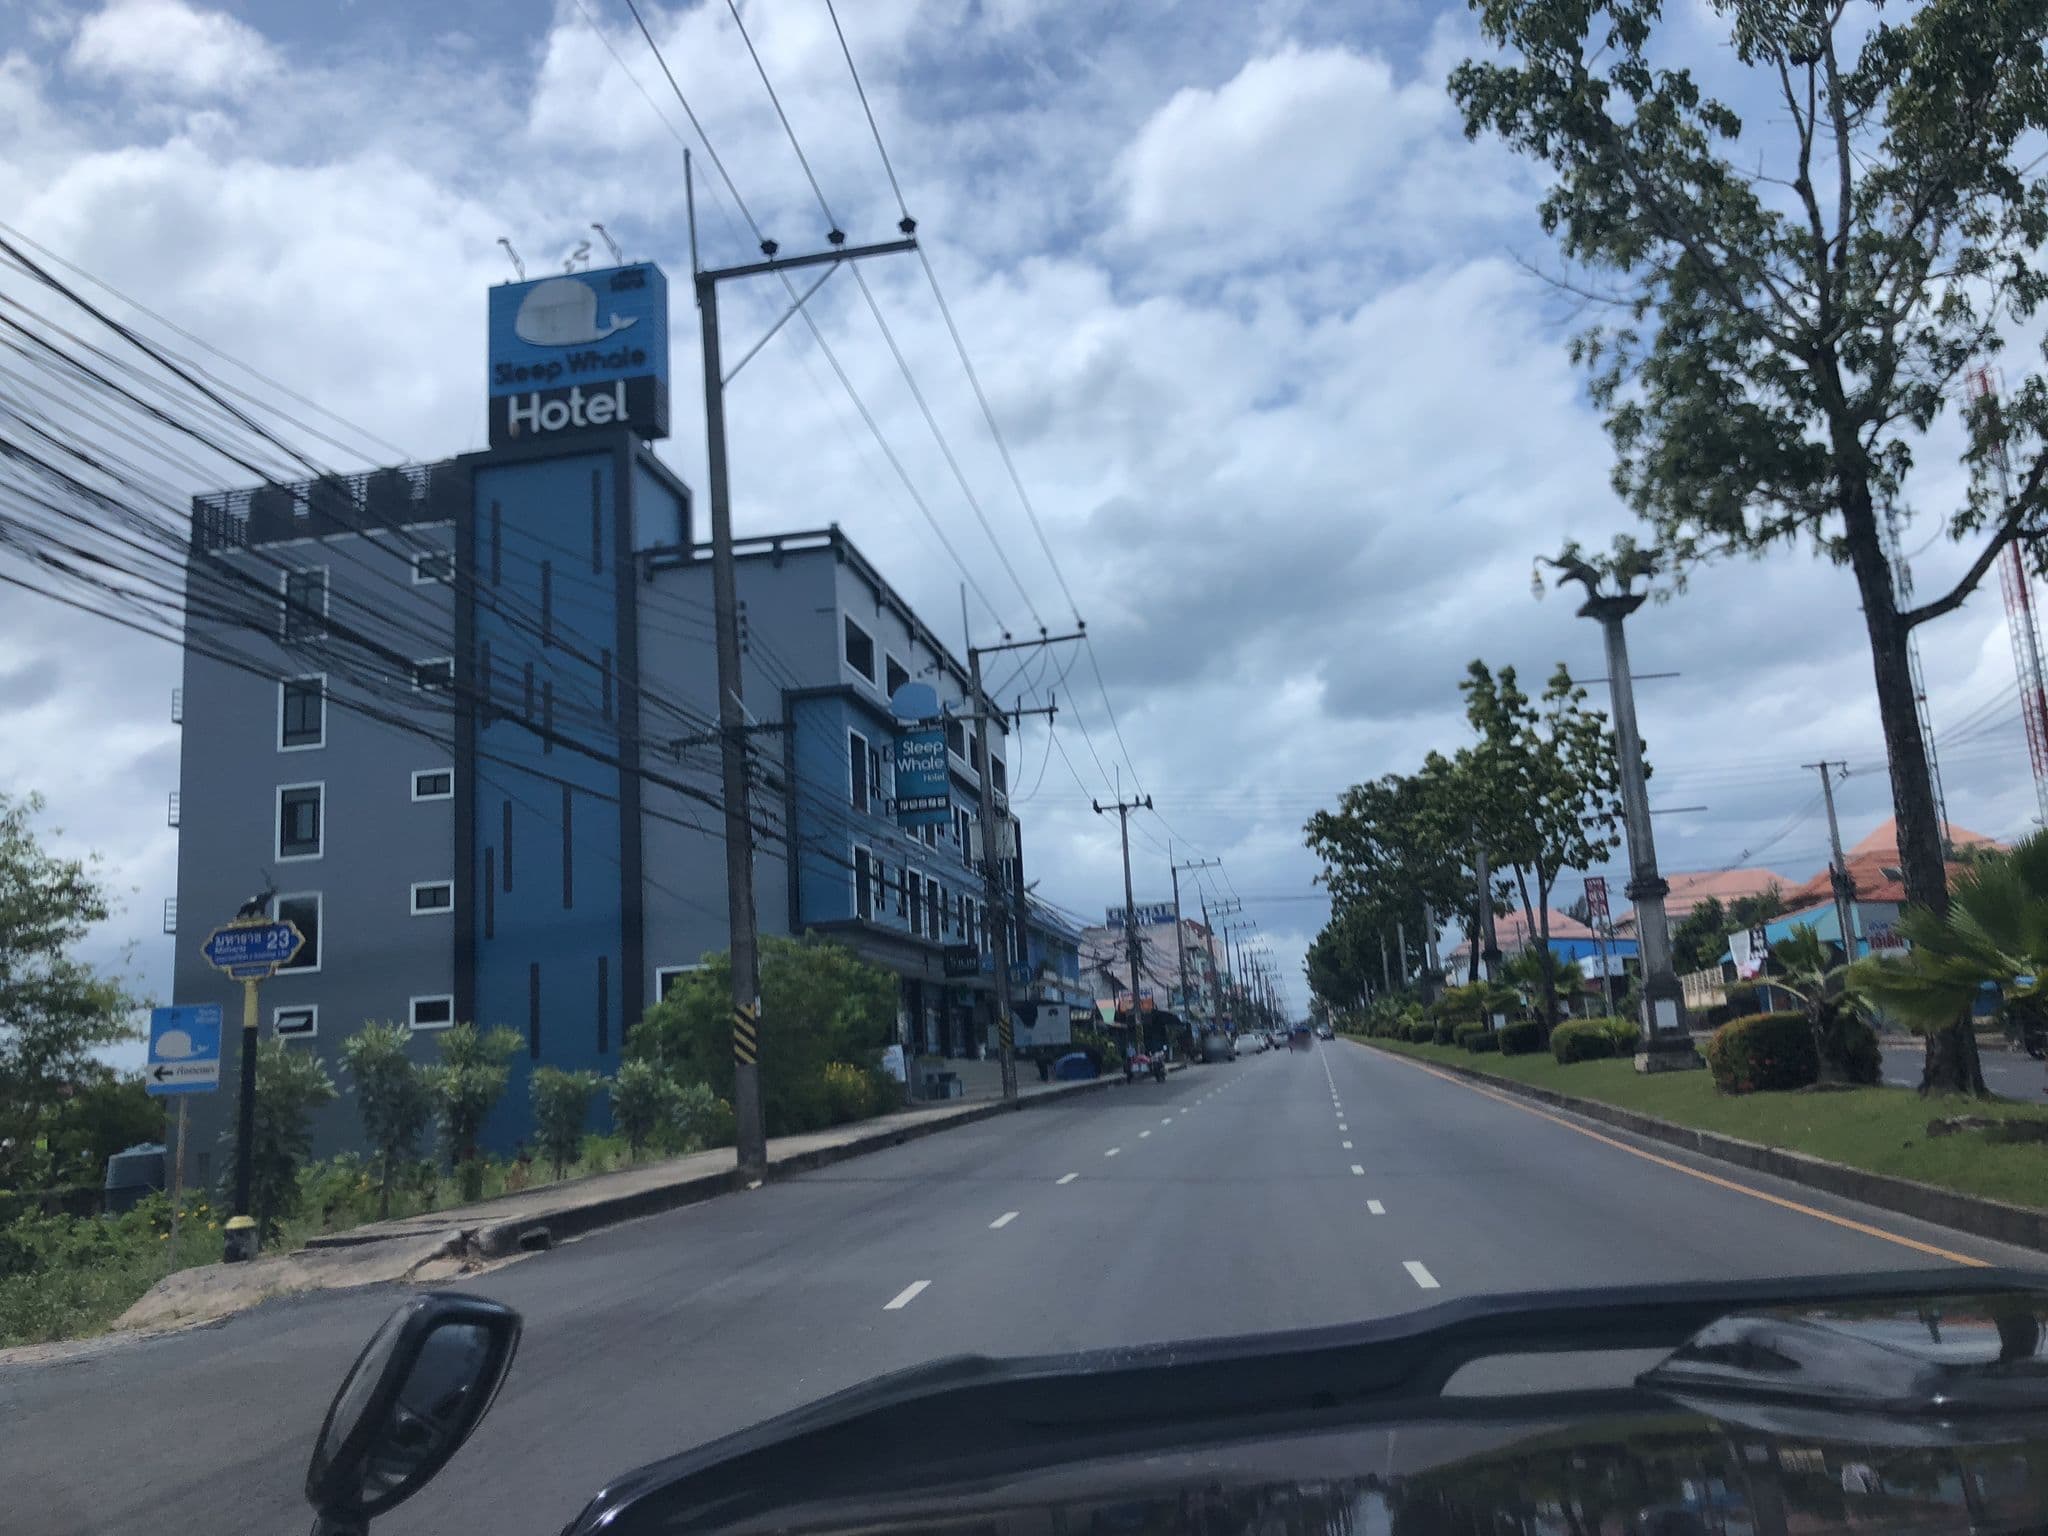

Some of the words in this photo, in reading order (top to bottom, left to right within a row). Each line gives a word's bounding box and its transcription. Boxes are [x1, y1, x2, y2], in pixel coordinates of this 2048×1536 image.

[494, 360, 563, 385] Sleep
[566, 346, 647, 374] Whale
[508, 378, 630, 438] Hotel
[902, 740, 944, 756] Sleep
[897, 756, 945, 773] Whale
[923, 773, 945, 782] Hotel
[267, 928, 290, 950] 23
